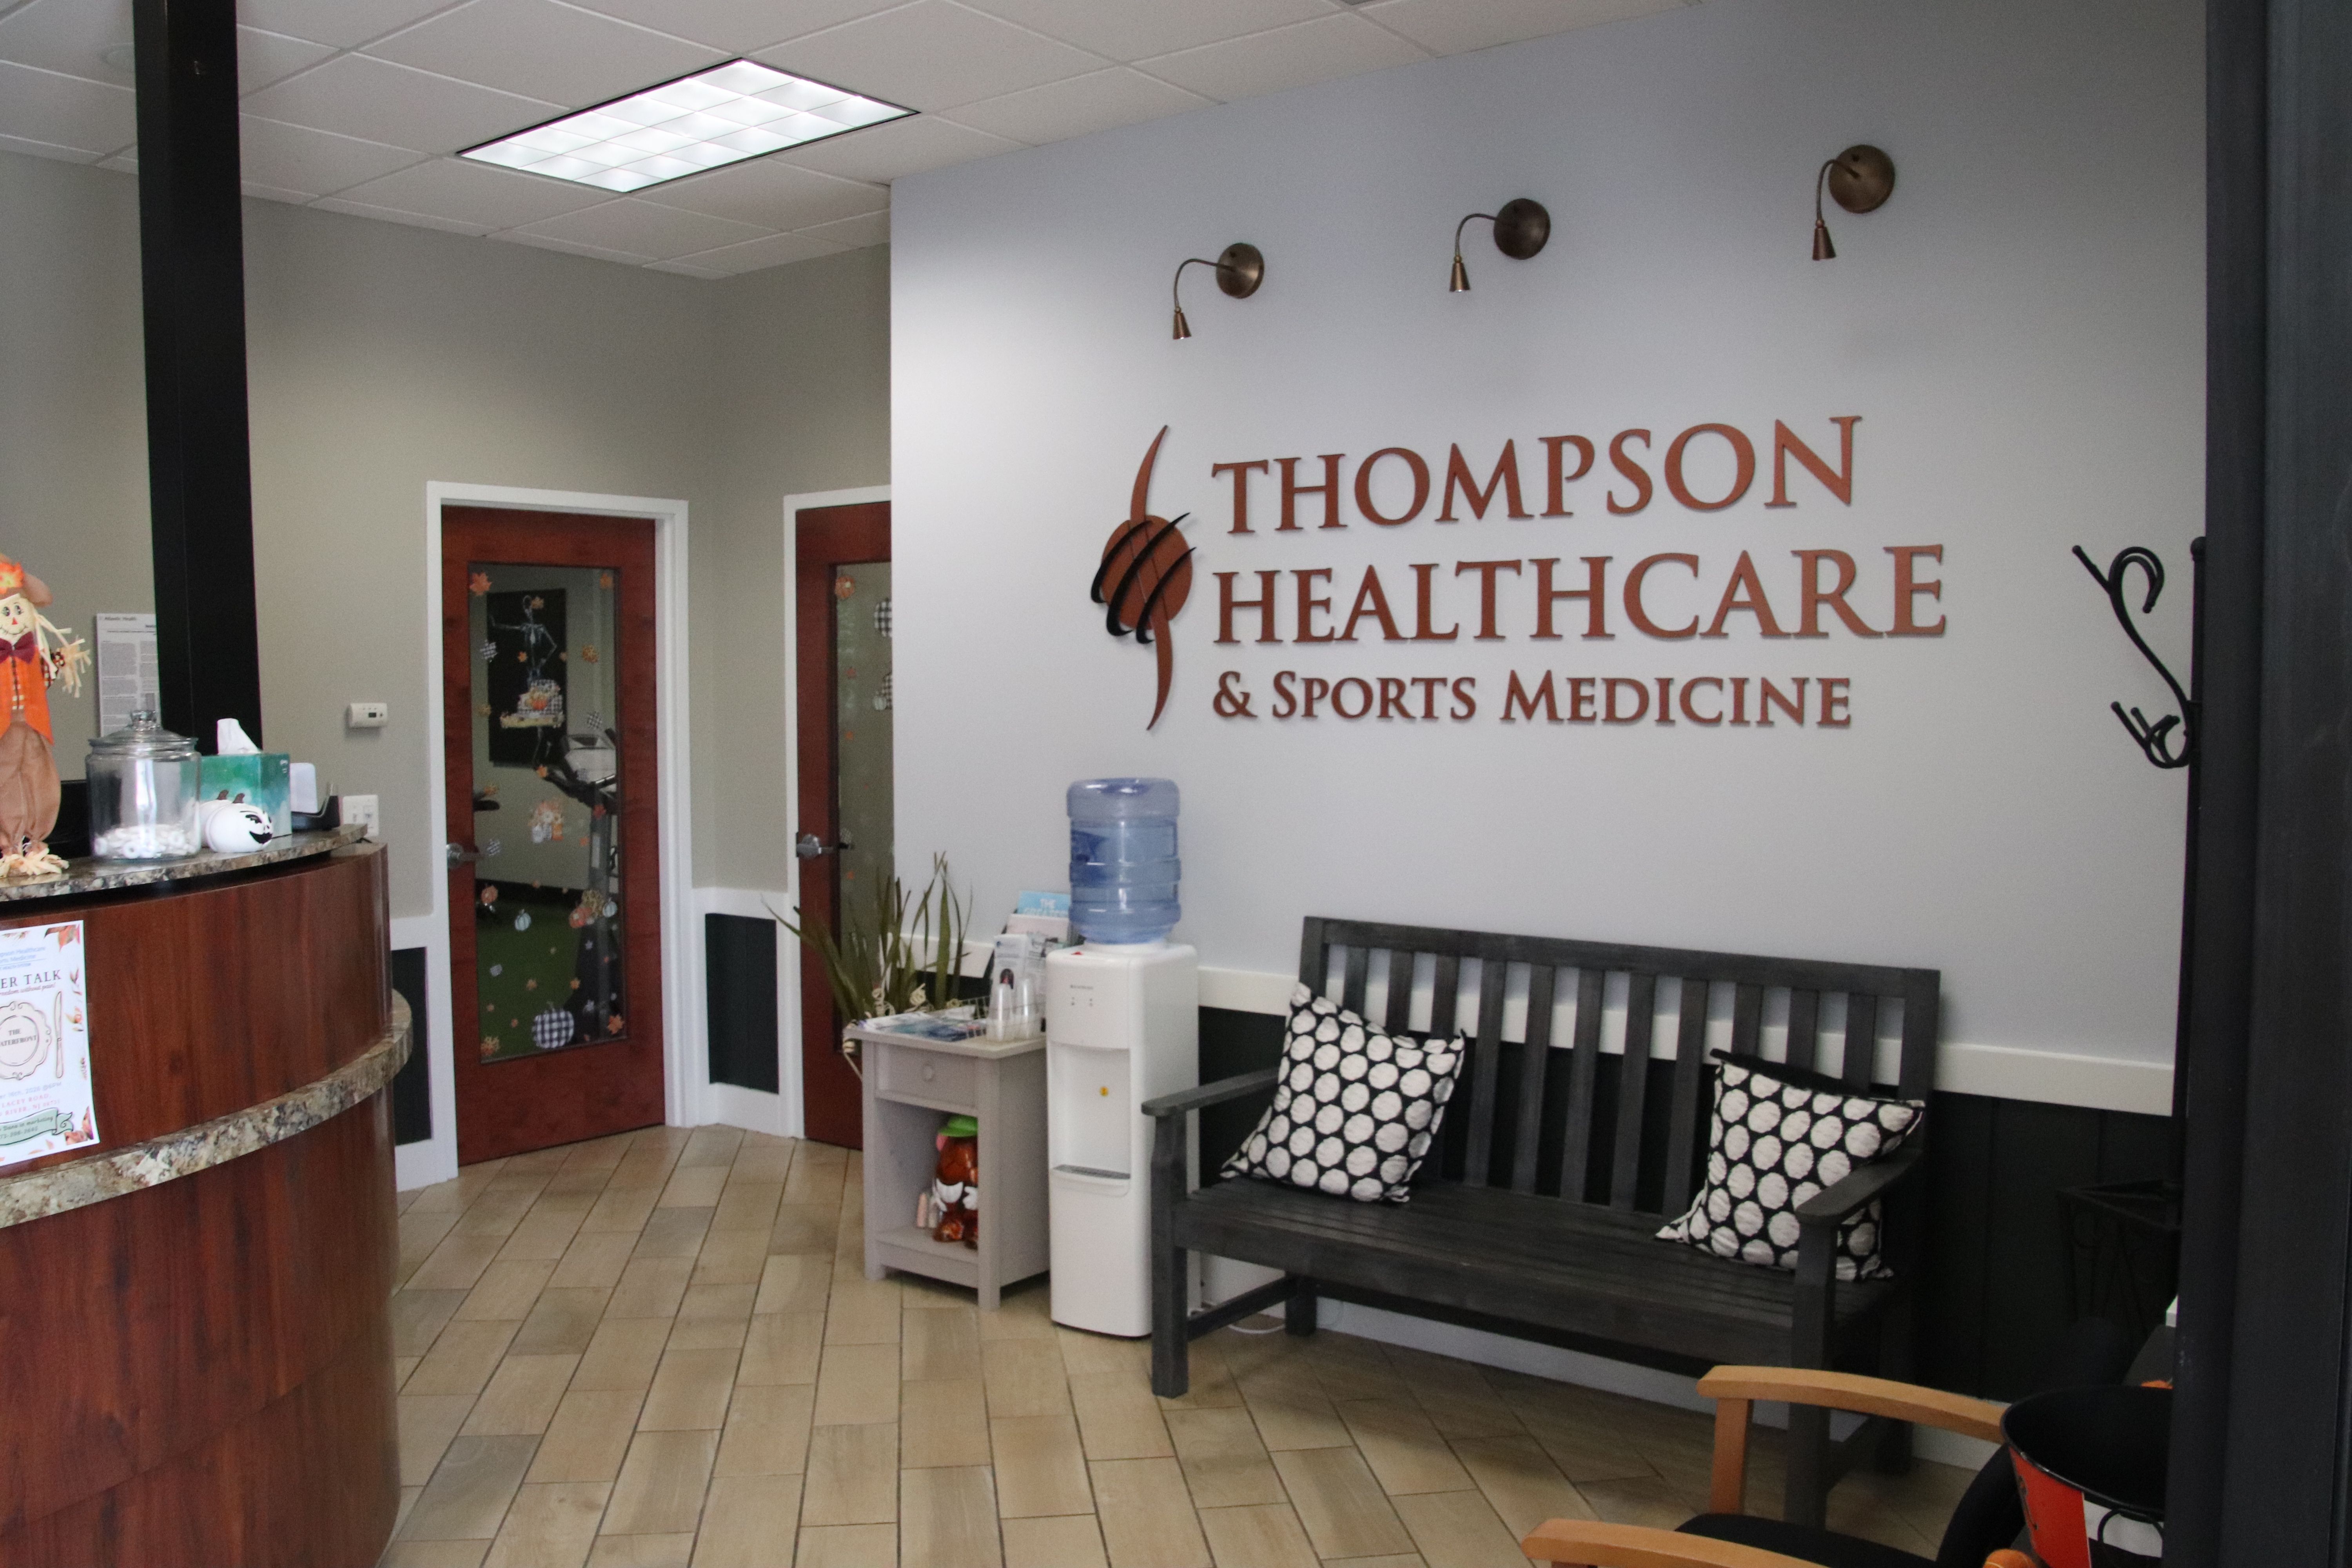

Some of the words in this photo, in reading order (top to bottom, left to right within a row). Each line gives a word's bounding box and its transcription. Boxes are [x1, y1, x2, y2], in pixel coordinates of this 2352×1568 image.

[1211, 416, 1863, 534] THOMPSON
[1212, 544, 1947, 643] HEALTHCARE
[1212, 671, 1257, 718] &
[1272, 670, 1476, 720] SPORTS
[1500, 669, 1851, 726] MEDICINE
[24, 969, 62, 985] TALK
[8, 1028, 22, 1036] THE
